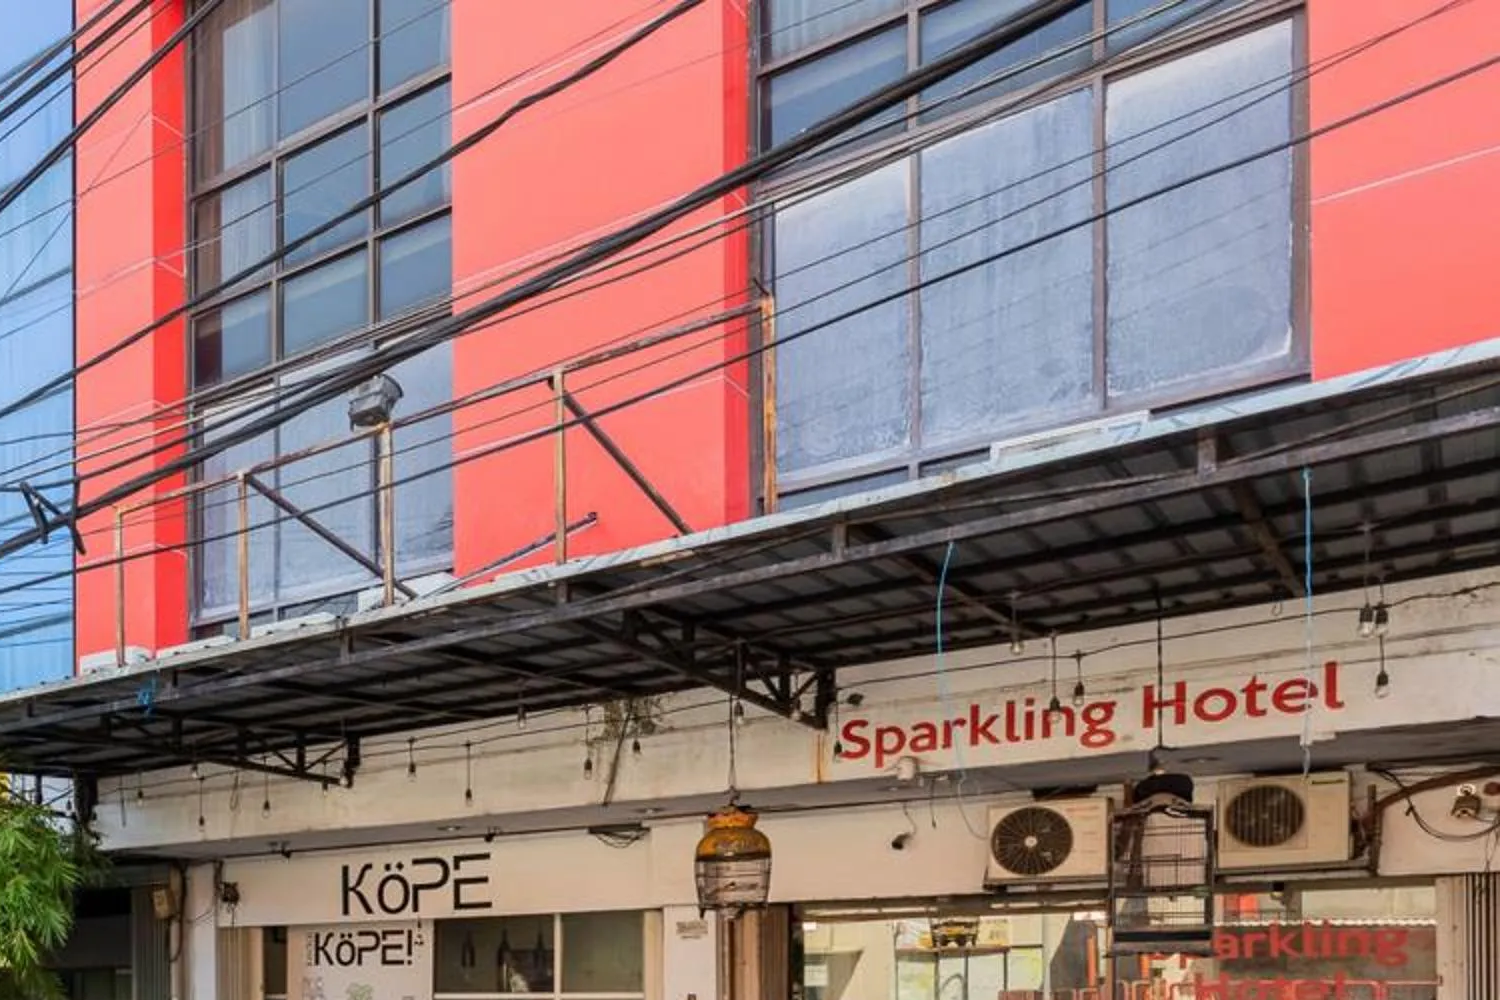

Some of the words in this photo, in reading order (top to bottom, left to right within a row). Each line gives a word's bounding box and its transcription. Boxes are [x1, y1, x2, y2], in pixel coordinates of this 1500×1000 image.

[840, 697, 1118, 768] Sparkling
[1142, 660, 1345, 729] Hotel
[341, 852, 493, 916] KöPE
[1148, 918, 1409, 968] arkling
